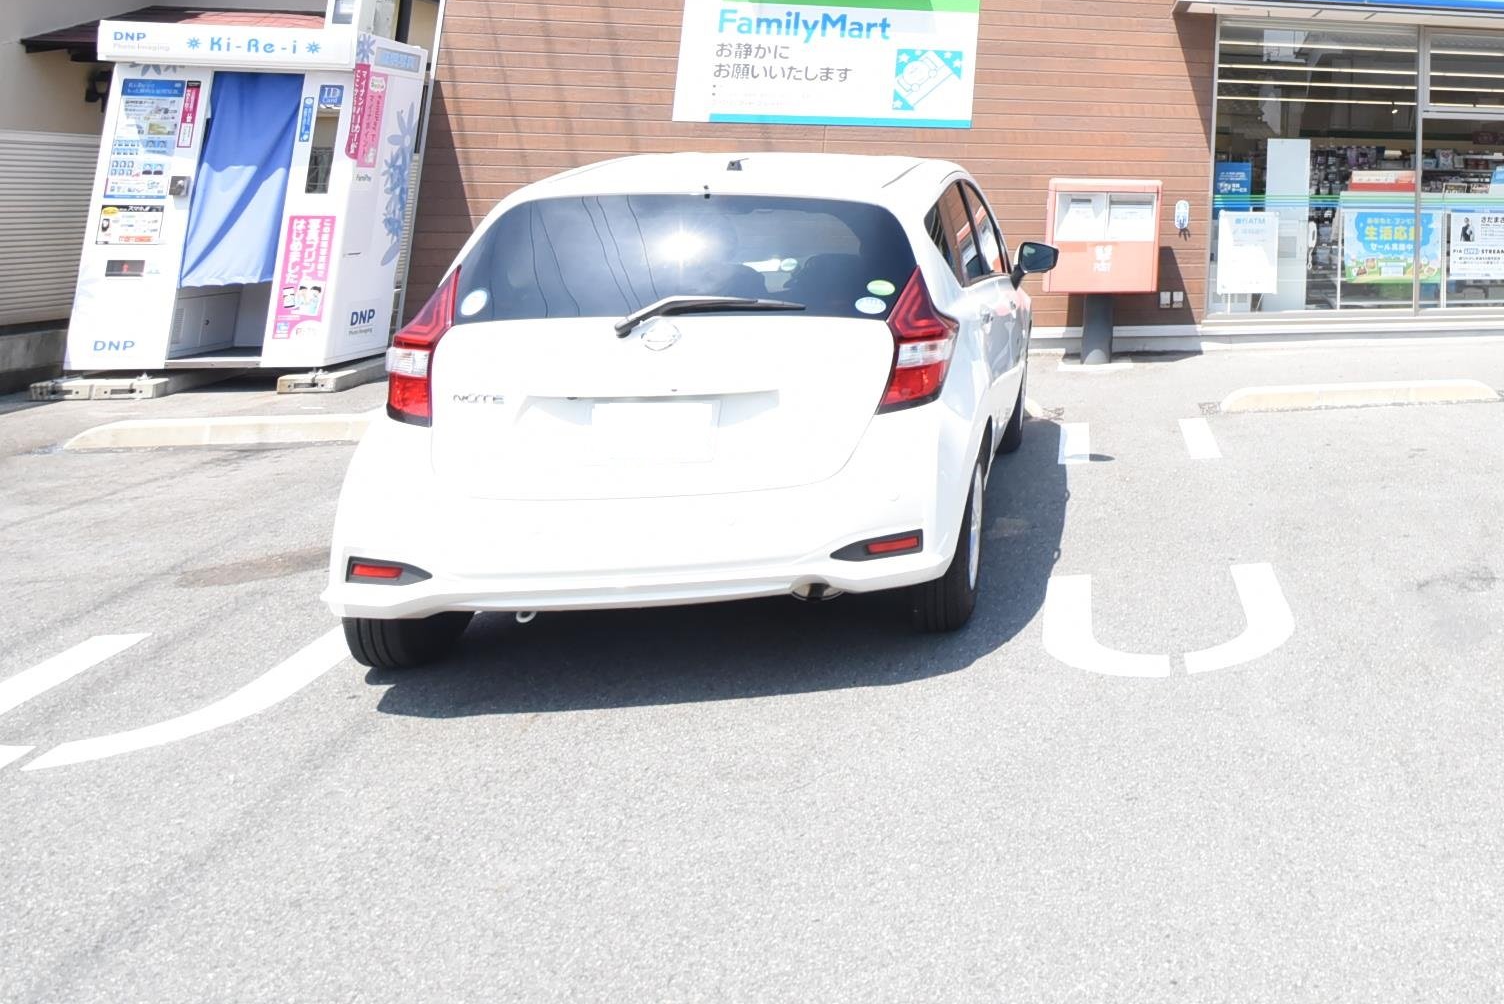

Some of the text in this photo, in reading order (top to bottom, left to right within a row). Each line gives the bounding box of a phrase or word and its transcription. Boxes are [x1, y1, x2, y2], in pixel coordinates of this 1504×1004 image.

[717, 9, 892, 43] FamilyMart
[113, 31, 147, 42] DNP
[715, 42, 791, 61] お静かに
[712, 62, 854, 84] お願いいたします
[323, 86, 340, 98] ID
[349, 308, 376, 327] DNP
[92, 339, 136, 352] DNP
